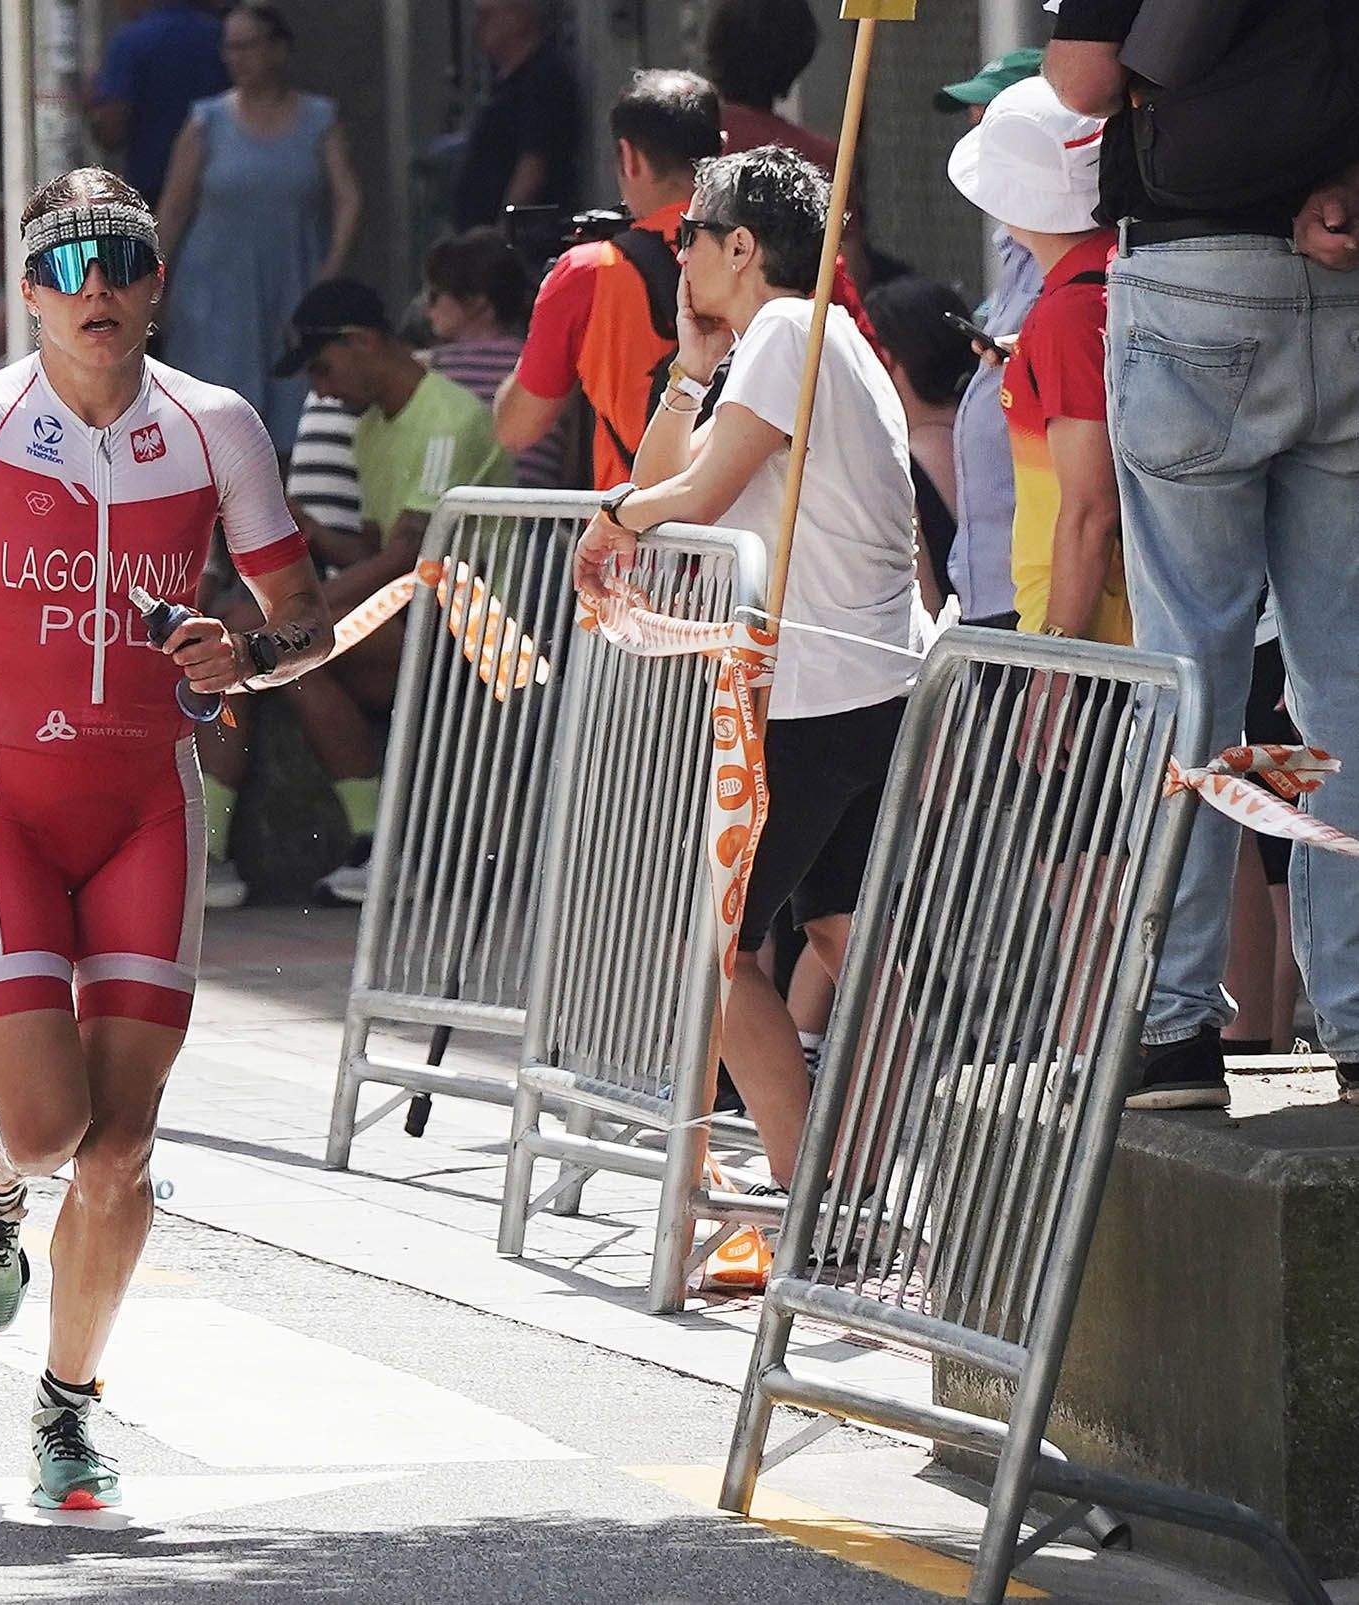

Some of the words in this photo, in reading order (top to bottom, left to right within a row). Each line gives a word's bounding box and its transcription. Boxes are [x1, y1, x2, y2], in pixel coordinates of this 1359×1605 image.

[26, 445, 64, 465] Triathlon
[32, 441, 59, 456] World
[2, 541, 193, 596] LAGOWNIK
[39, 604, 149, 646] POL
